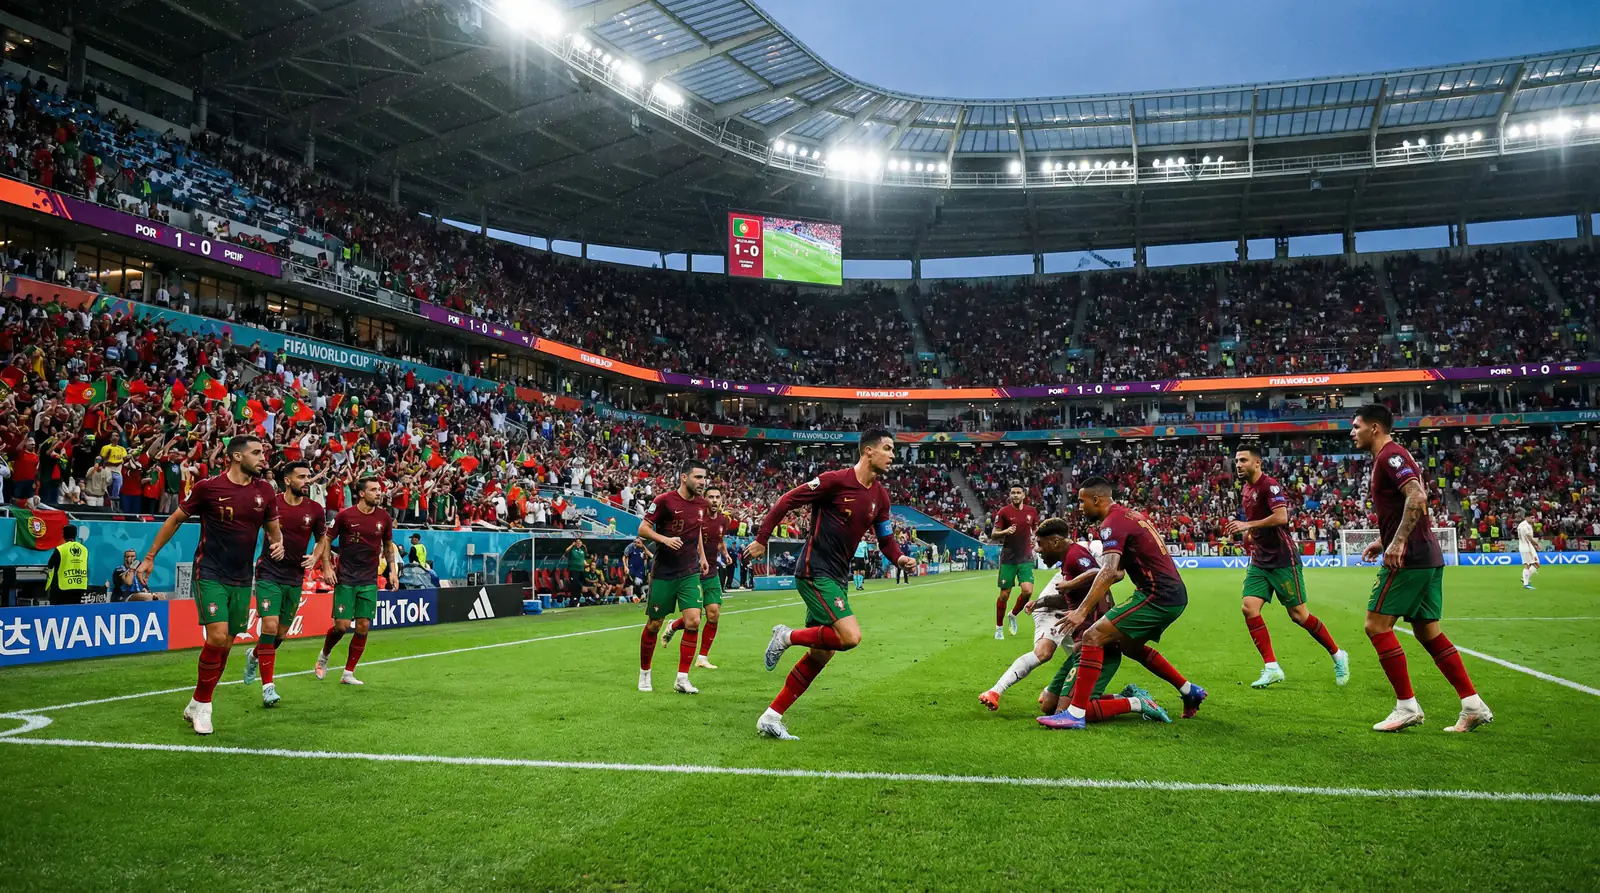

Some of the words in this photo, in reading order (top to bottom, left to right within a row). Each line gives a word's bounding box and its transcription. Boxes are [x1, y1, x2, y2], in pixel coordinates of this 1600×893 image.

[135, 223, 156, 238] POR
[175, 232, 182, 247] 1
[201, 240, 211, 255] 0
[469, 319, 474, 330] 1
[482, 322, 488, 334] 0
[283, 338, 308, 356] FIFA
[309, 343, 348, 364] WORLD
[349, 353, 370, 369] CUP
[1520, 366, 1527, 375] 1
[1541, 364, 1550, 374] 0
[710, 379, 715, 388] 1
[722, 381, 728, 390] 0
[1269, 377, 1286, 385] FIFA
[1077, 385, 1083, 394] 1
[1095, 385, 1103, 394] 0
[792, 431, 807, 439] FIFA
[671, 519, 685, 532] 23
[1174, 559, 1198, 568] vo
[1222, 557, 1251, 568] viv
[1468, 553, 1512, 565] vivo
[1544, 551, 1590, 564] vivo
[373, 597, 430, 626] TikTok
[34, 612, 164, 651] WANDA
